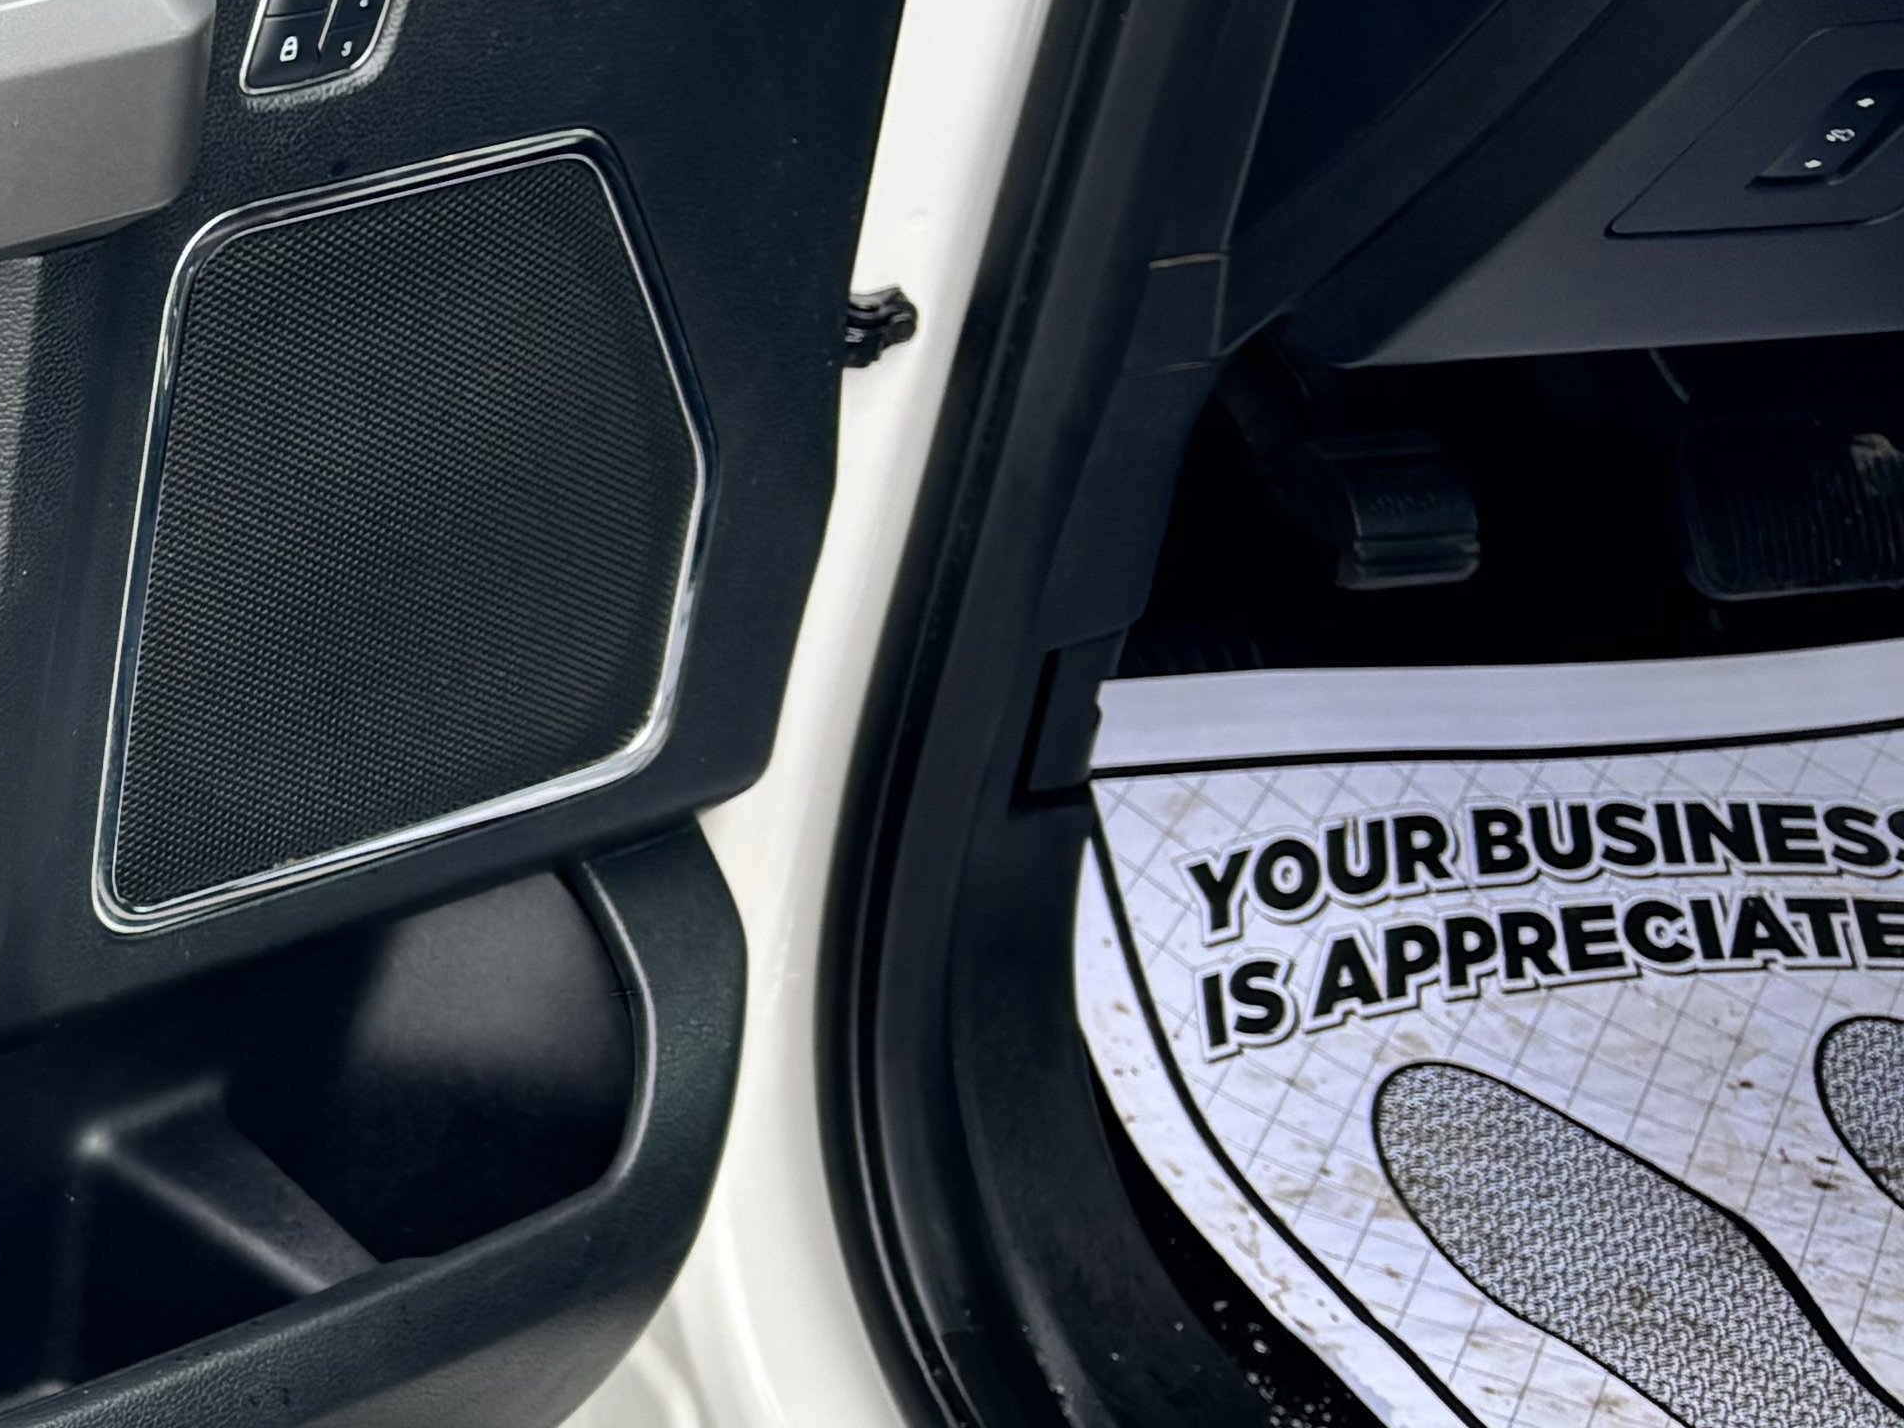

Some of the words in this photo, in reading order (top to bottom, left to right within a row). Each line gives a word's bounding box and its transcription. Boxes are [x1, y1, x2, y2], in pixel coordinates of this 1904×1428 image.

[341, 41, 353, 57] 3
[1188, 814, 1453, 931] YOUR
[1472, 802, 1904, 875] BUSINES
[1201, 960, 1287, 1047] IS
[1312, 896, 1904, 1018] APPRECIATE
